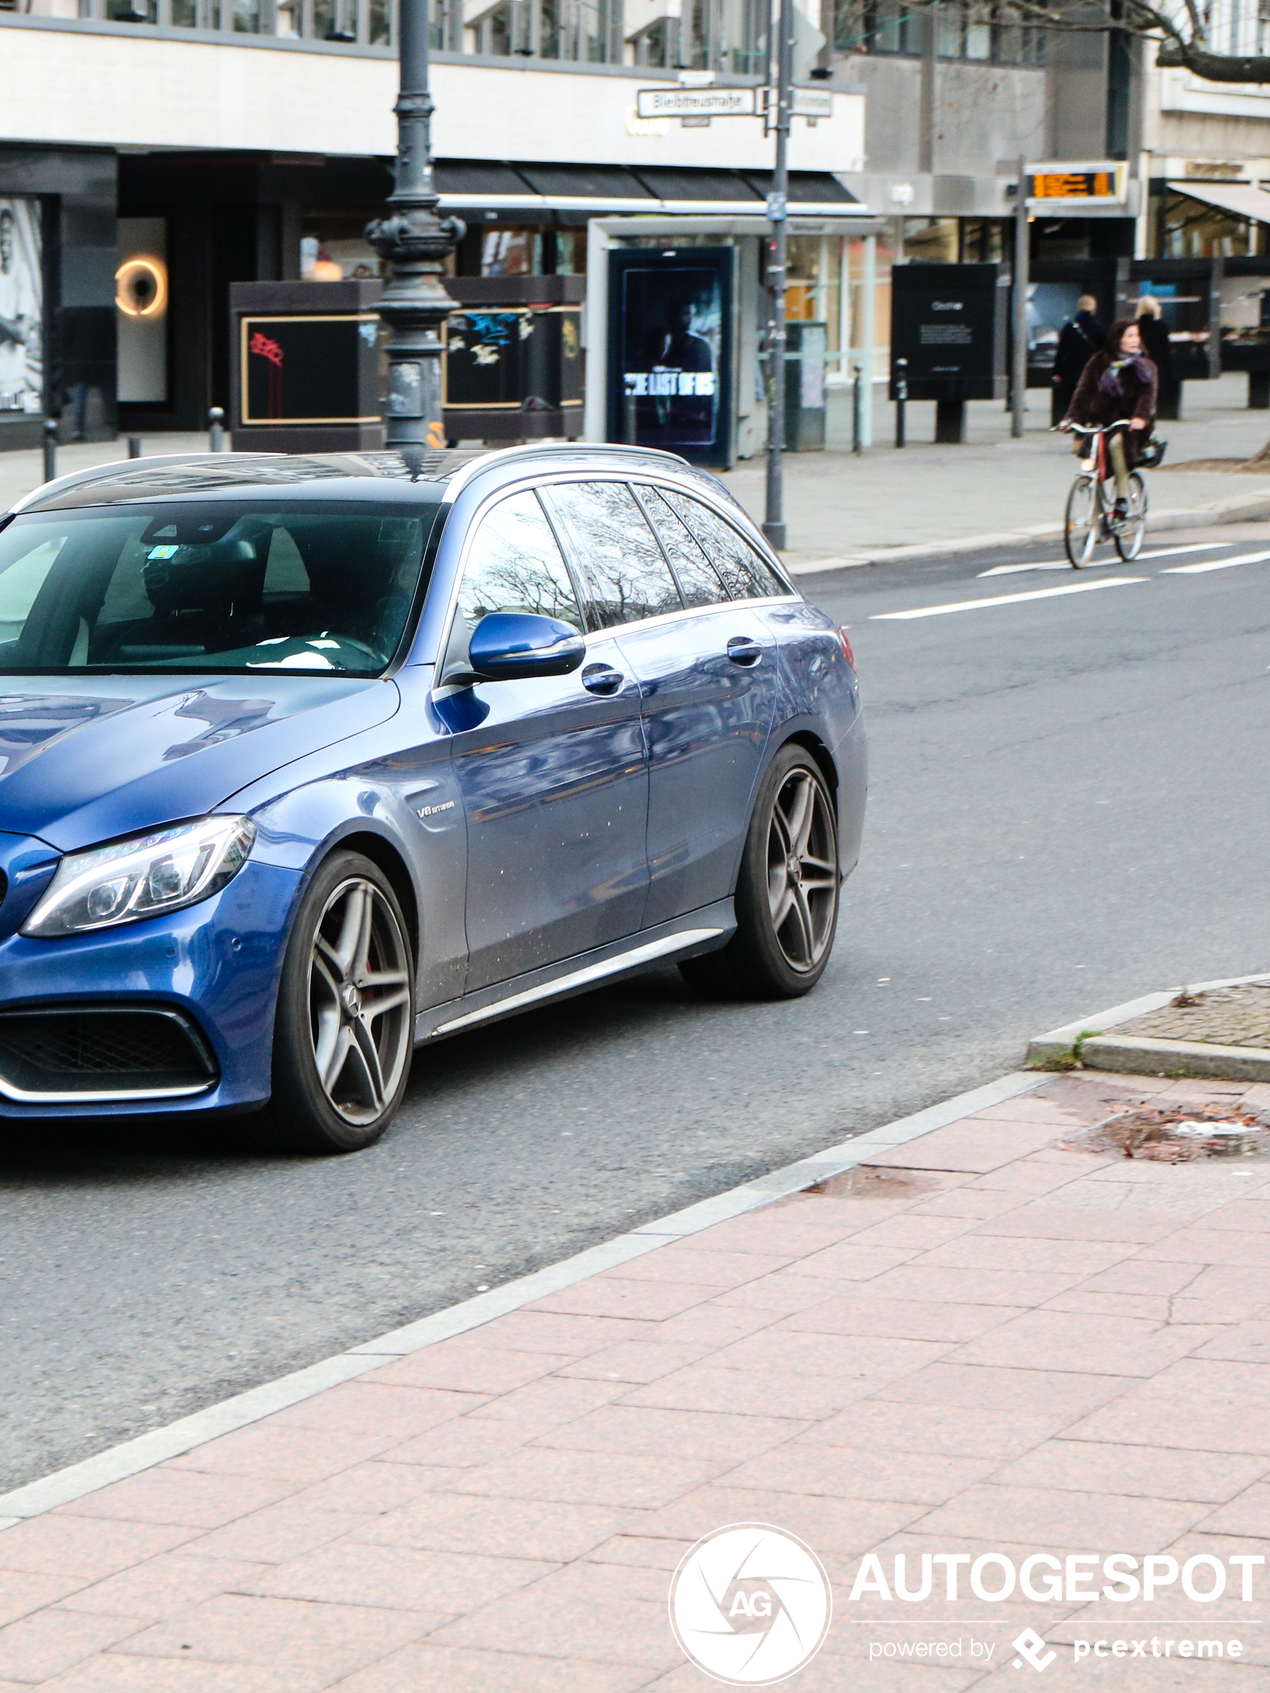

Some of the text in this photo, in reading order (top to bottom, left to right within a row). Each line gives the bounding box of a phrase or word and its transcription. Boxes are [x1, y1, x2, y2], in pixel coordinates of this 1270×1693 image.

[649, 372, 677, 395] LAST
[678, 372, 694, 395] OF
[695, 372, 714, 395] US
[417, 805, 432, 818] V8
